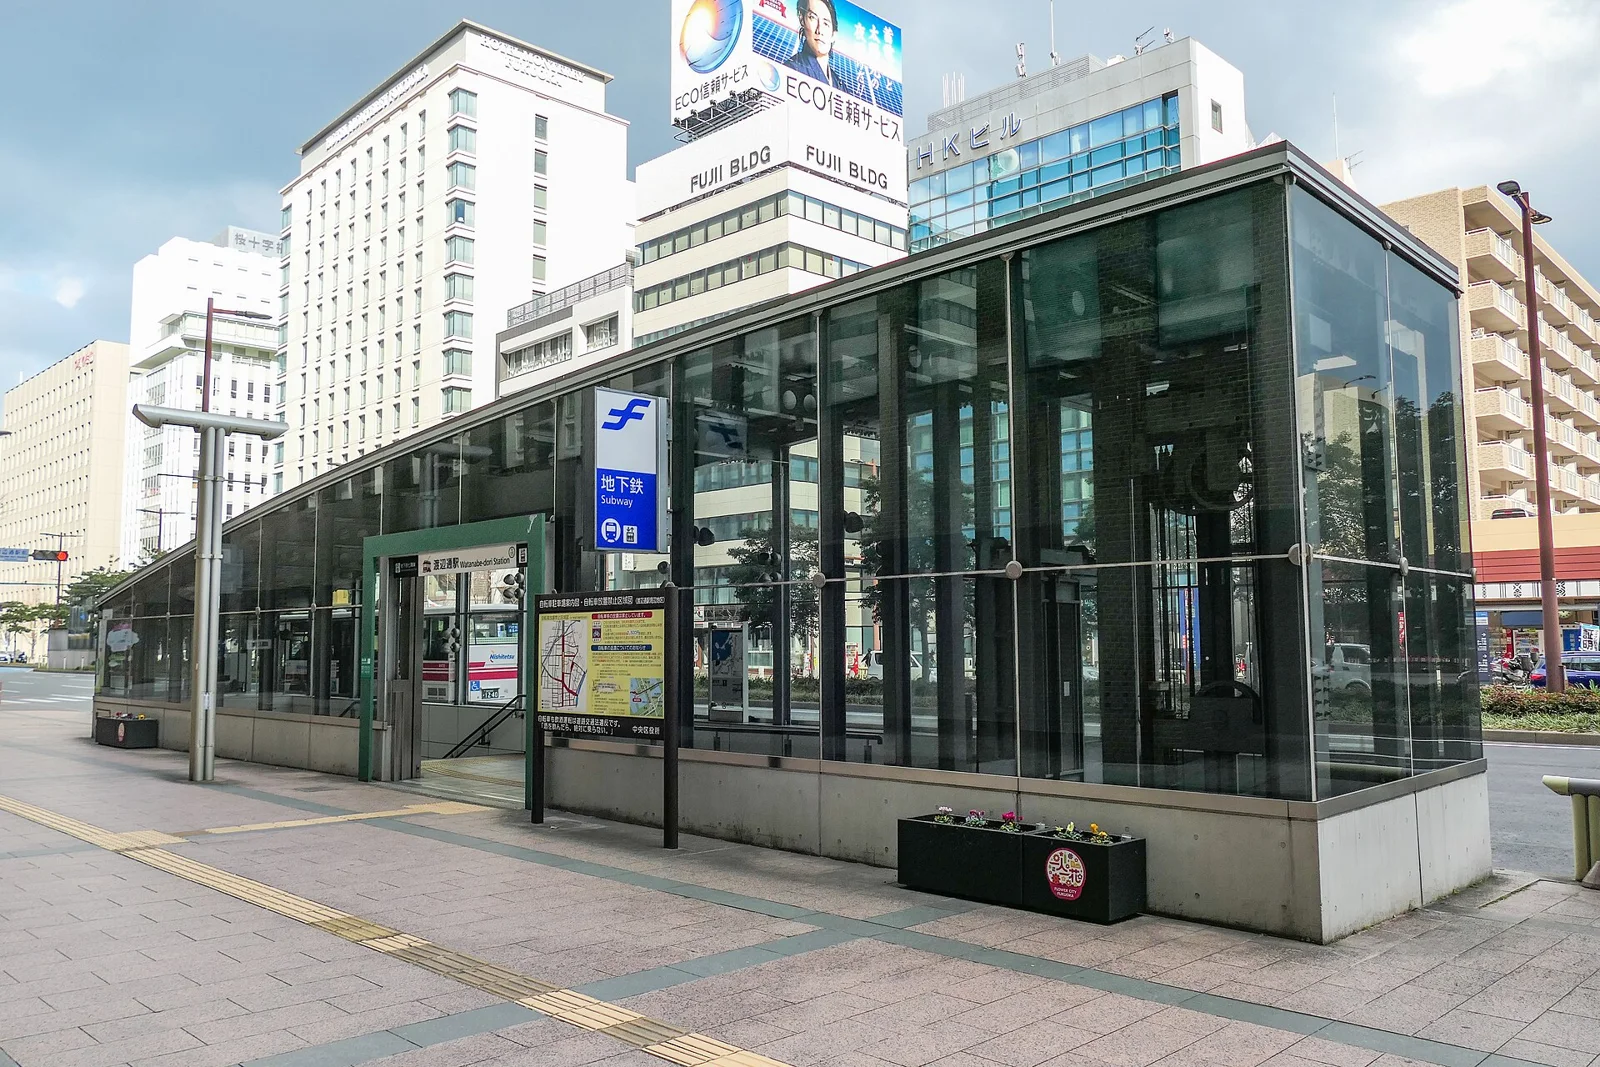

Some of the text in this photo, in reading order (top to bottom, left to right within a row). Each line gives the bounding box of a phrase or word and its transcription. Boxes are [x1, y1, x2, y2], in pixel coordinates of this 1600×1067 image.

[675, 64, 750, 111] ECO信頼サービス
[786, 76, 902, 142] ECO信頼サービス
[916, 111, 1023, 170] HKビル
[690, 145, 772, 193] FUJII BLDG
[806, 144, 889, 190] FUJII BLDG
[600, 474, 644, 495] 地下鉄
[600, 494, 634, 508] Subway
[493, 556, 511, 566] Station
[632, 725, 660, 735] 中央区役所
